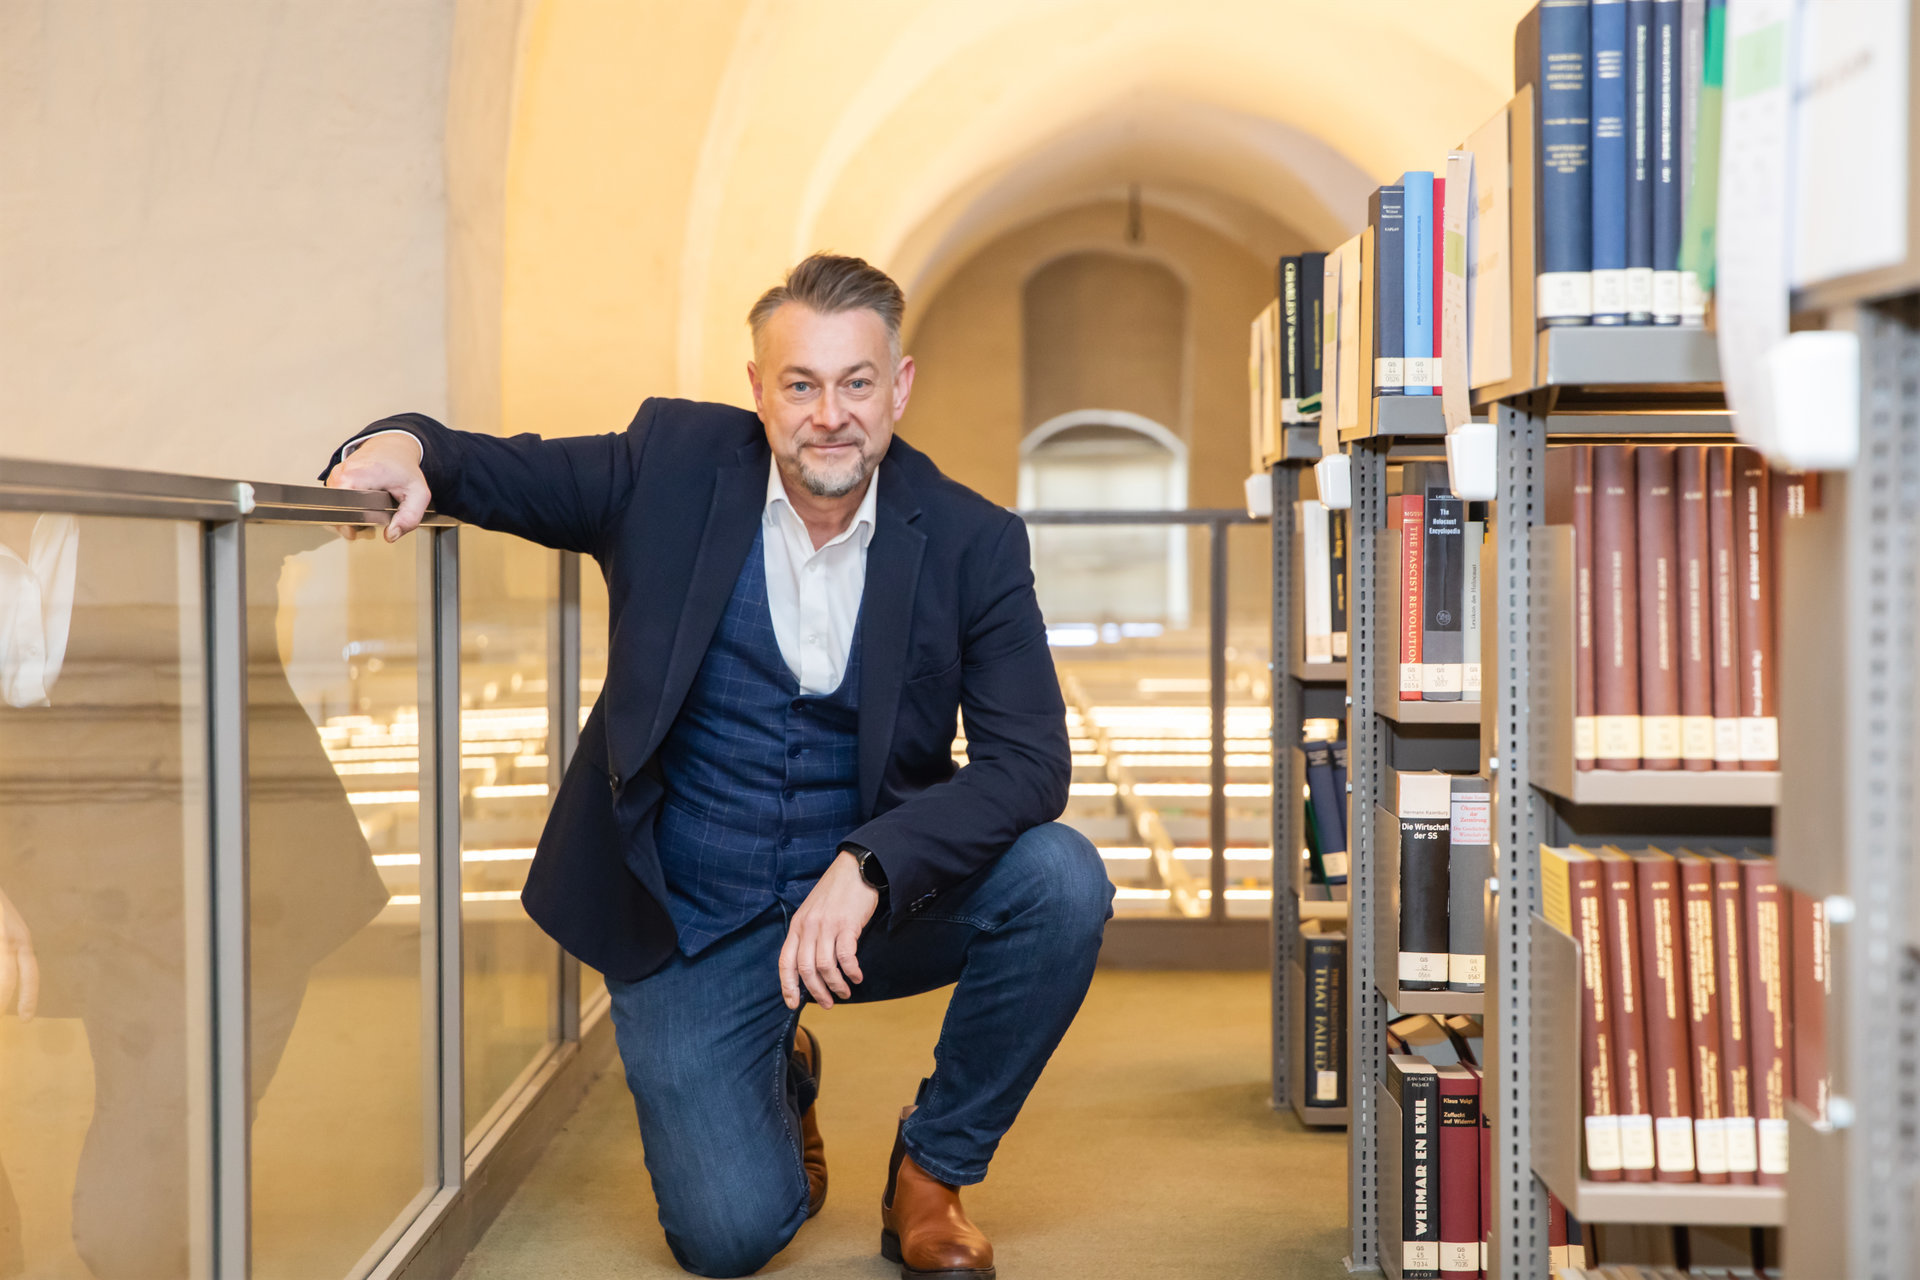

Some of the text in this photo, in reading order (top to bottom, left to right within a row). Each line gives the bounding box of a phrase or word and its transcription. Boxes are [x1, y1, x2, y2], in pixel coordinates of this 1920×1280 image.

[1440, 508, 1449, 516] The
[1428, 527, 1461, 535] Encyclopedia
[1408, 526, 1418, 664] THE FASCIST REVOLUTION
[1414, 823, 1450, 831] Wirtschaft
[1413, 832, 1438, 840] der SS
[1313, 966, 1328, 1072] THAT FAILED
[1415, 1097, 1428, 1236] WEIMAR EN EXIL
